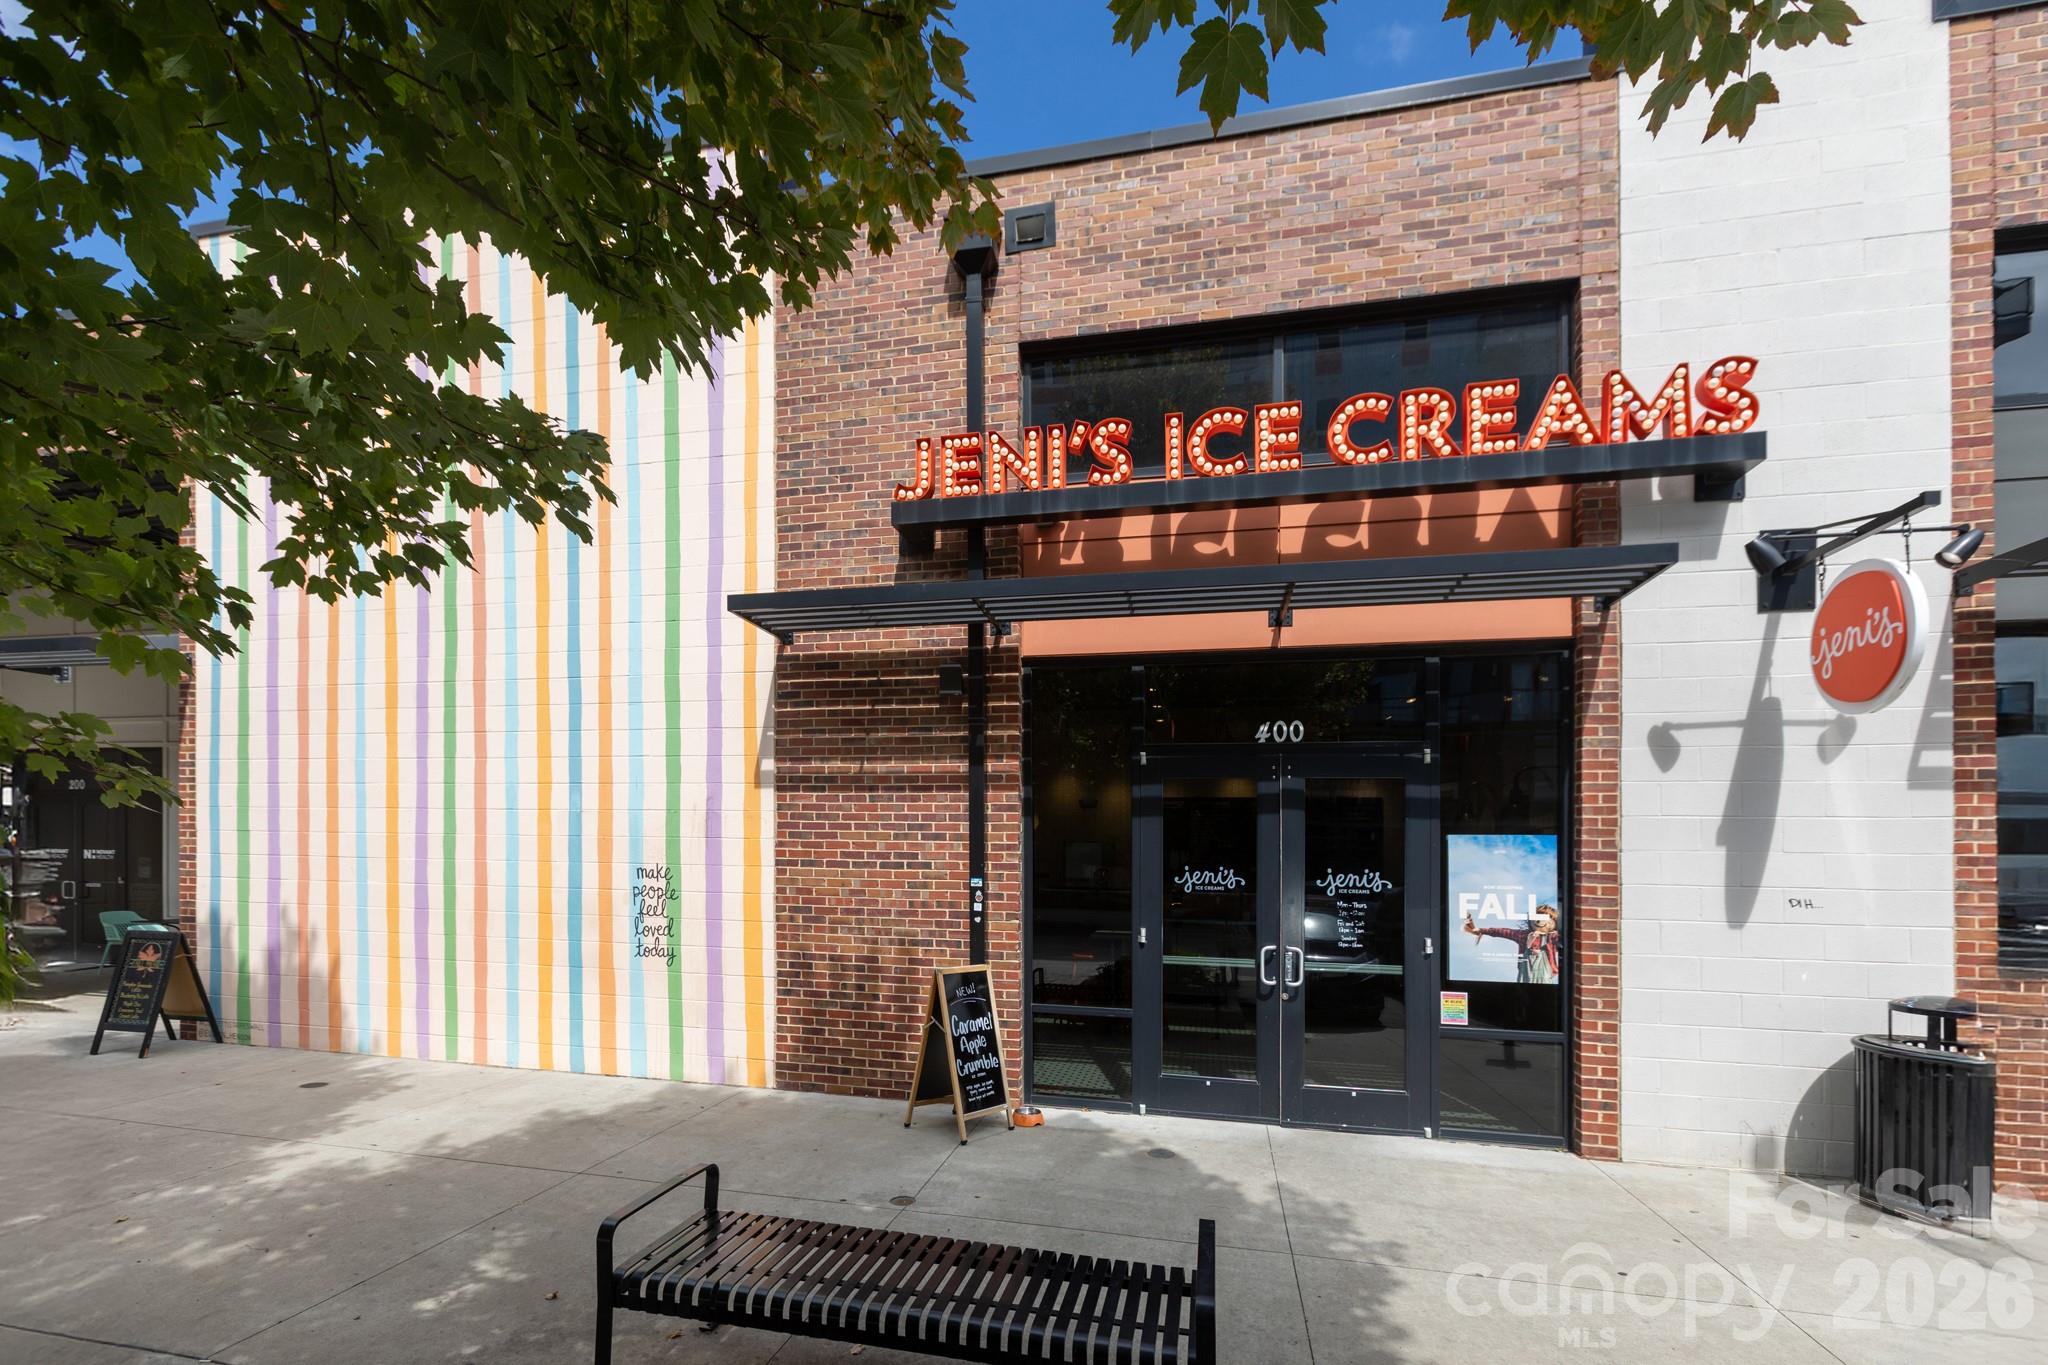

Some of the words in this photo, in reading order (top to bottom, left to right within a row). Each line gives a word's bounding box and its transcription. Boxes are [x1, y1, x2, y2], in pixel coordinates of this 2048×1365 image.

[894, 418, 1134, 501] JENI'S
[1164, 399, 1303, 480] ICE
[1328, 355, 1760, 467] CREAMS
[1812, 605, 1905, 680] jeni's
[1255, 719, 1305, 743] 400
[68, 779, 86, 790] 200
[636, 862, 674, 882] make
[1174, 865, 1246, 893] jeni's
[1316, 868, 1393, 896] jeni's
[632, 881, 679, 906] people
[637, 898, 669, 923] feel
[1458, 892, 1551, 921] FALL
[634, 916, 675, 938] loved
[634, 936, 677, 967] today
[956, 982, 977, 998] NEW!
[951, 1011, 993, 1037] Caramel
[960, 1034, 987, 1055] Apple
[956, 1052, 999, 1077] Crumble
